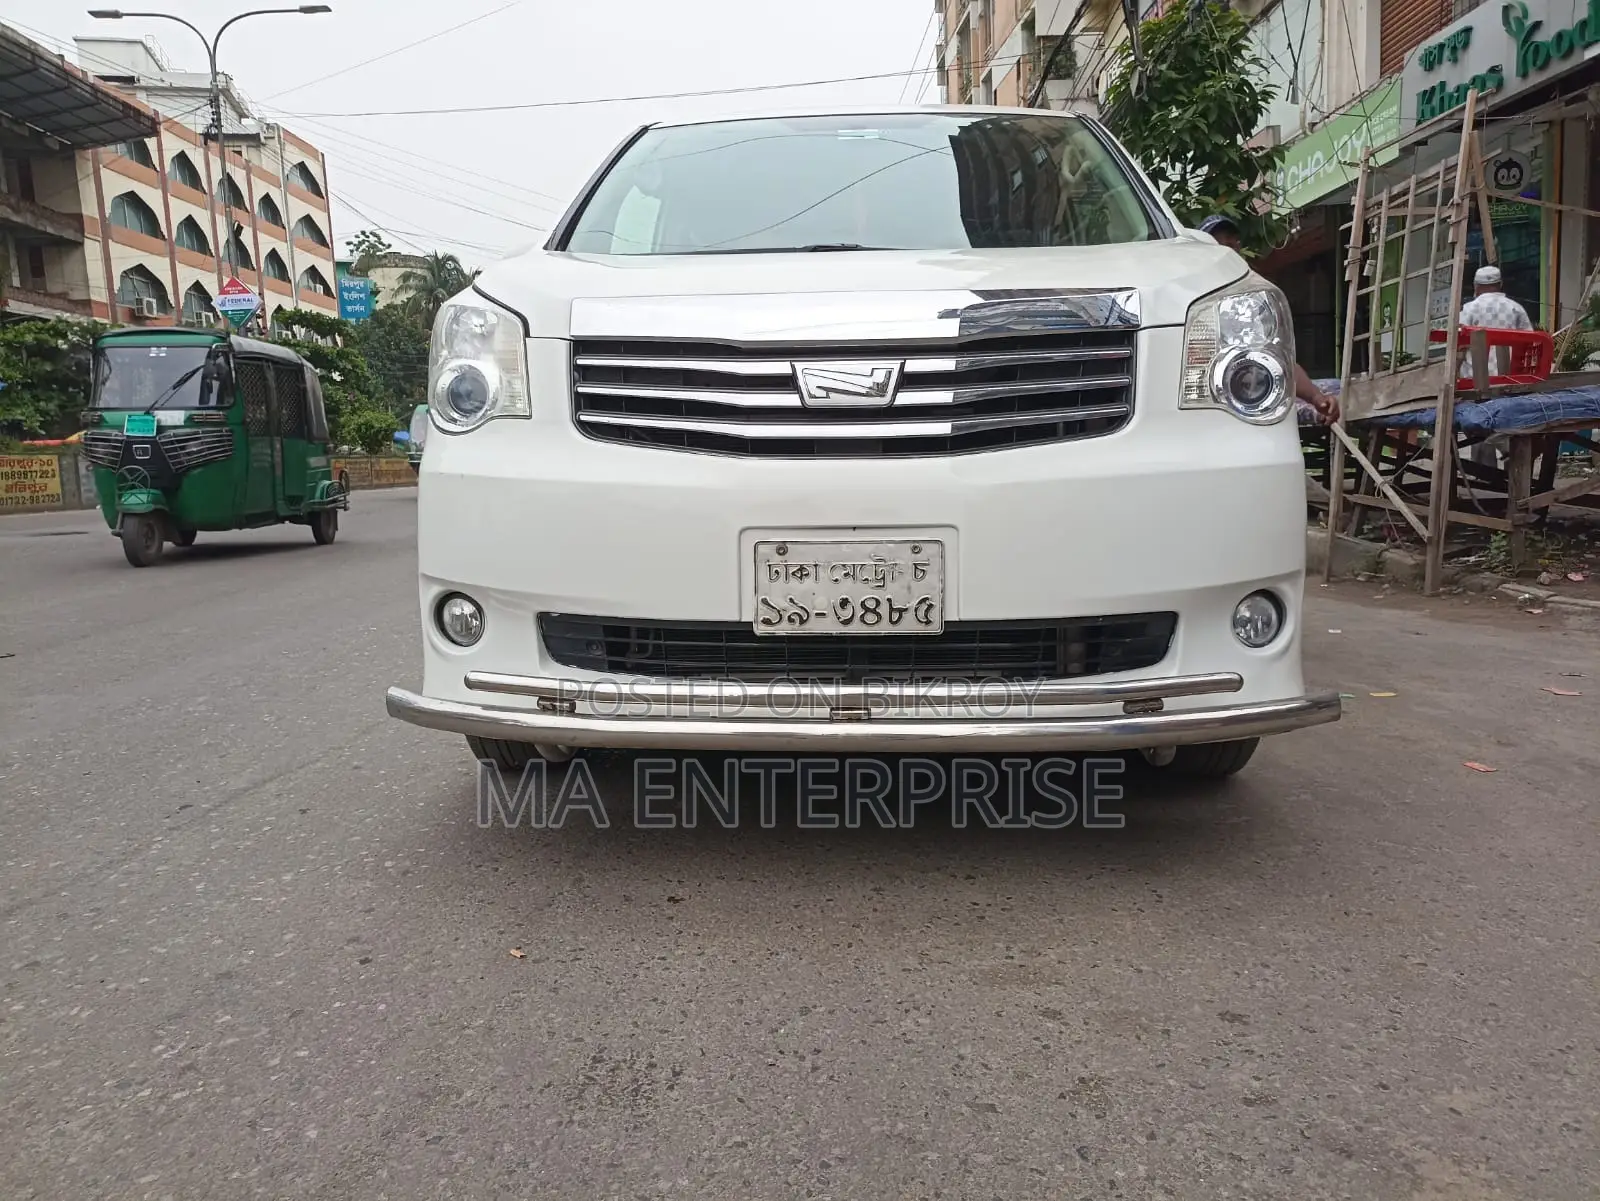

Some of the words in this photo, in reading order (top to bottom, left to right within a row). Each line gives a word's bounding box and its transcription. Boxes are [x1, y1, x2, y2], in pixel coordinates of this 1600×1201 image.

[766, 560, 821, 584] ঢাকা
[828, 553, 898, 591] মেট্রো
[912, 559, 931, 582] চ
